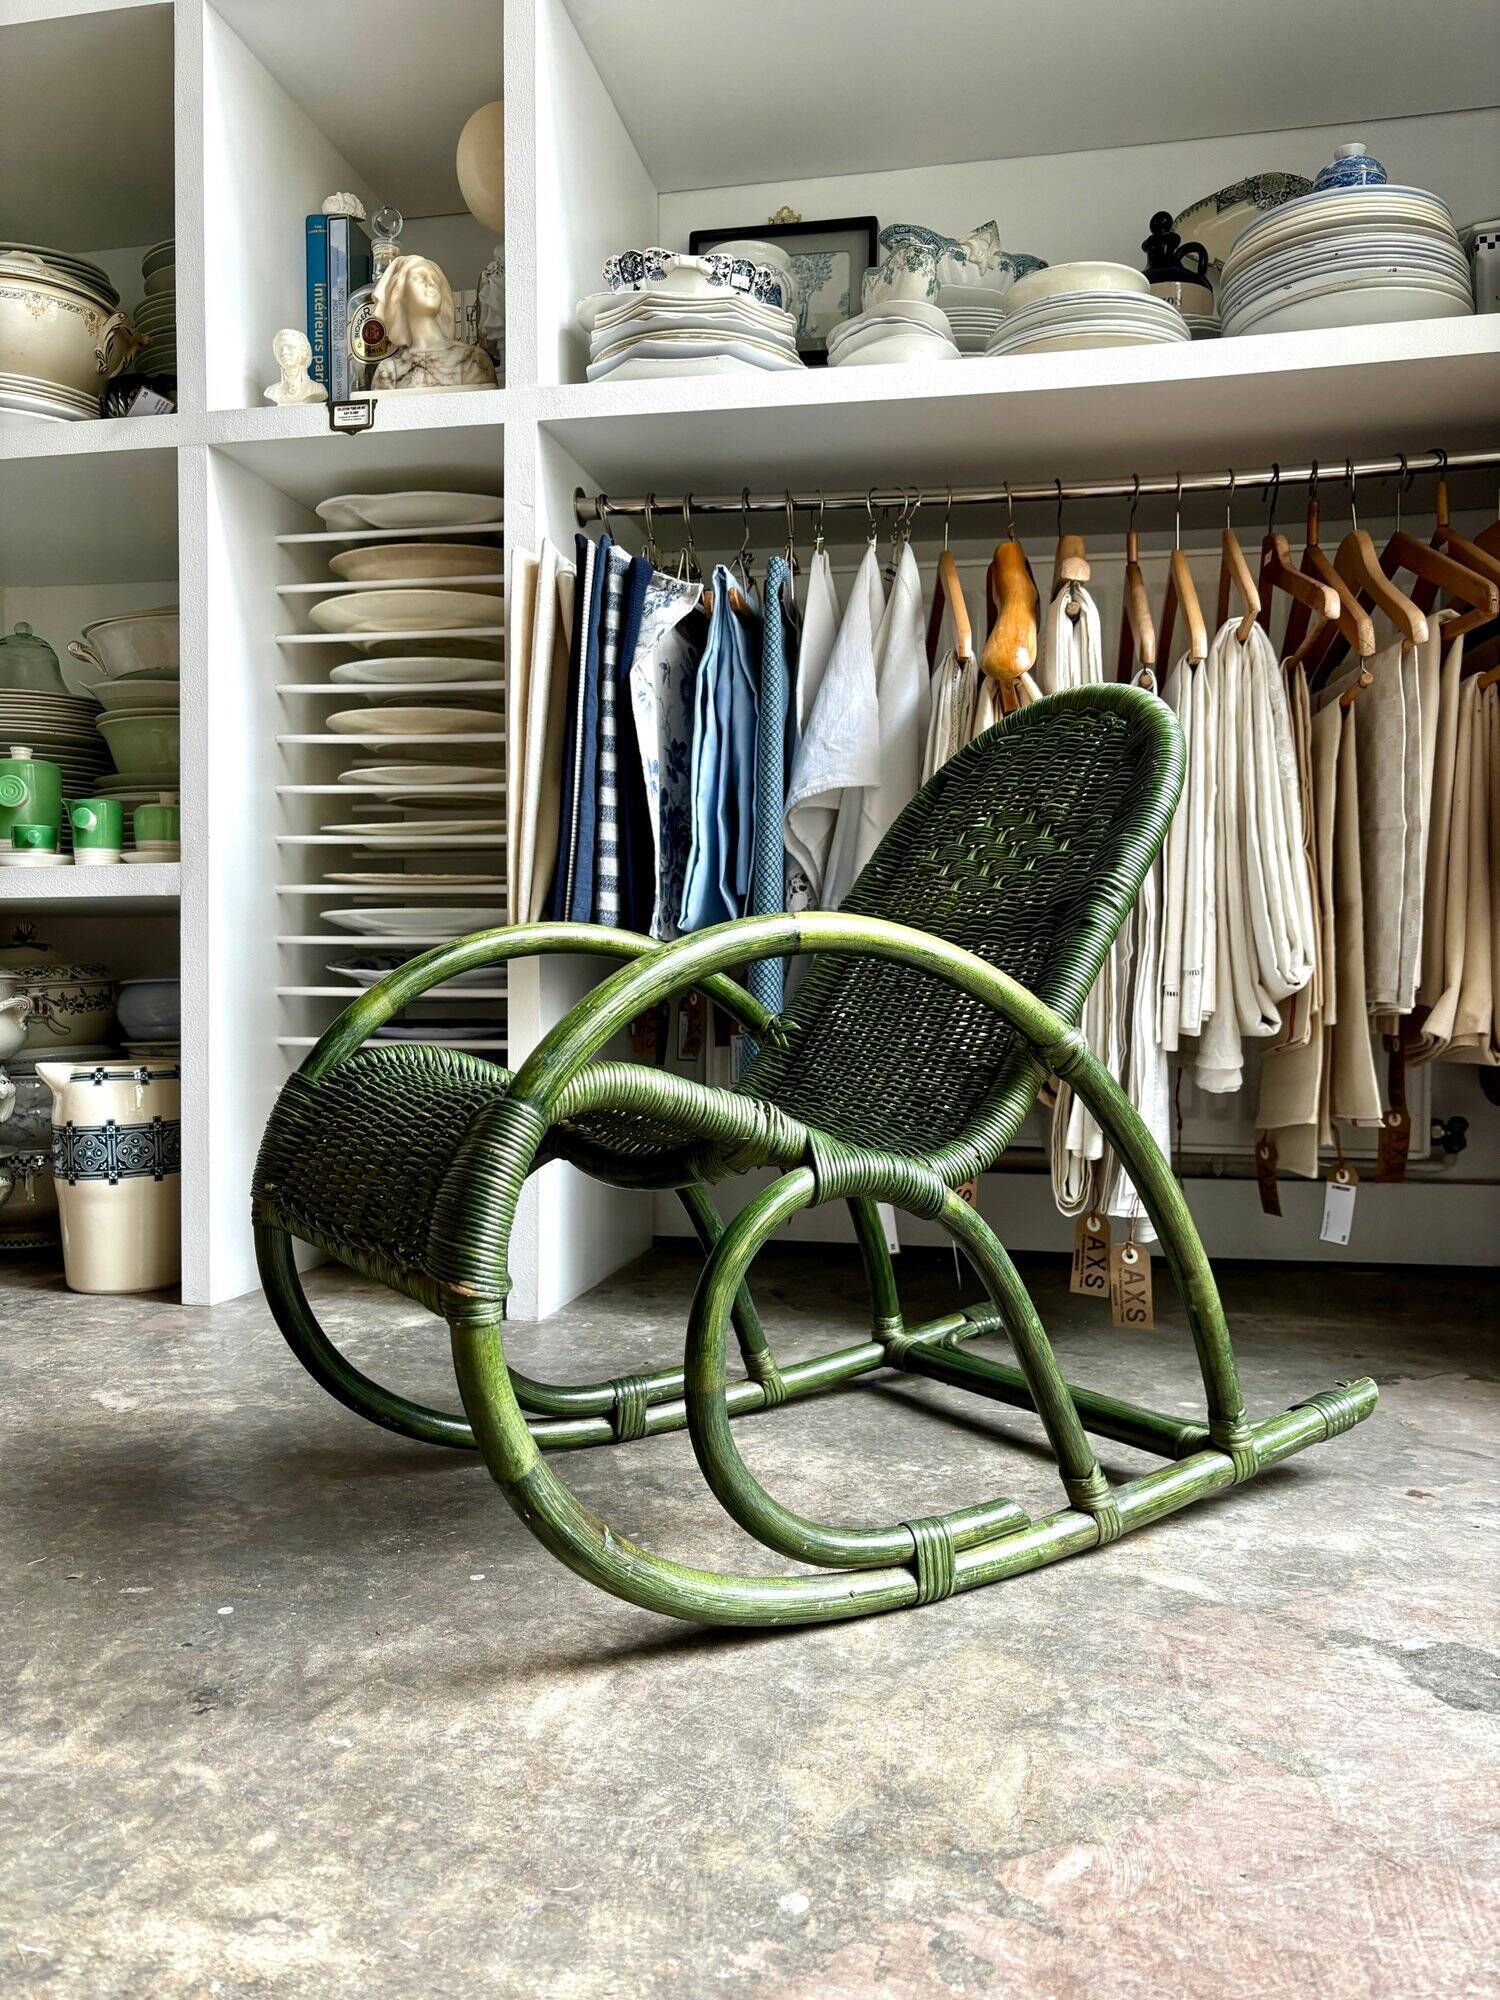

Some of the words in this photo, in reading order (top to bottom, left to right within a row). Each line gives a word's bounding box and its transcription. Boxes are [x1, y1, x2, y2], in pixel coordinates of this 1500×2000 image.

[312, 355, 328, 382] pari
[1085, 1235, 1107, 1289] AXS
[1124, 1268, 1147, 1322] AXS
